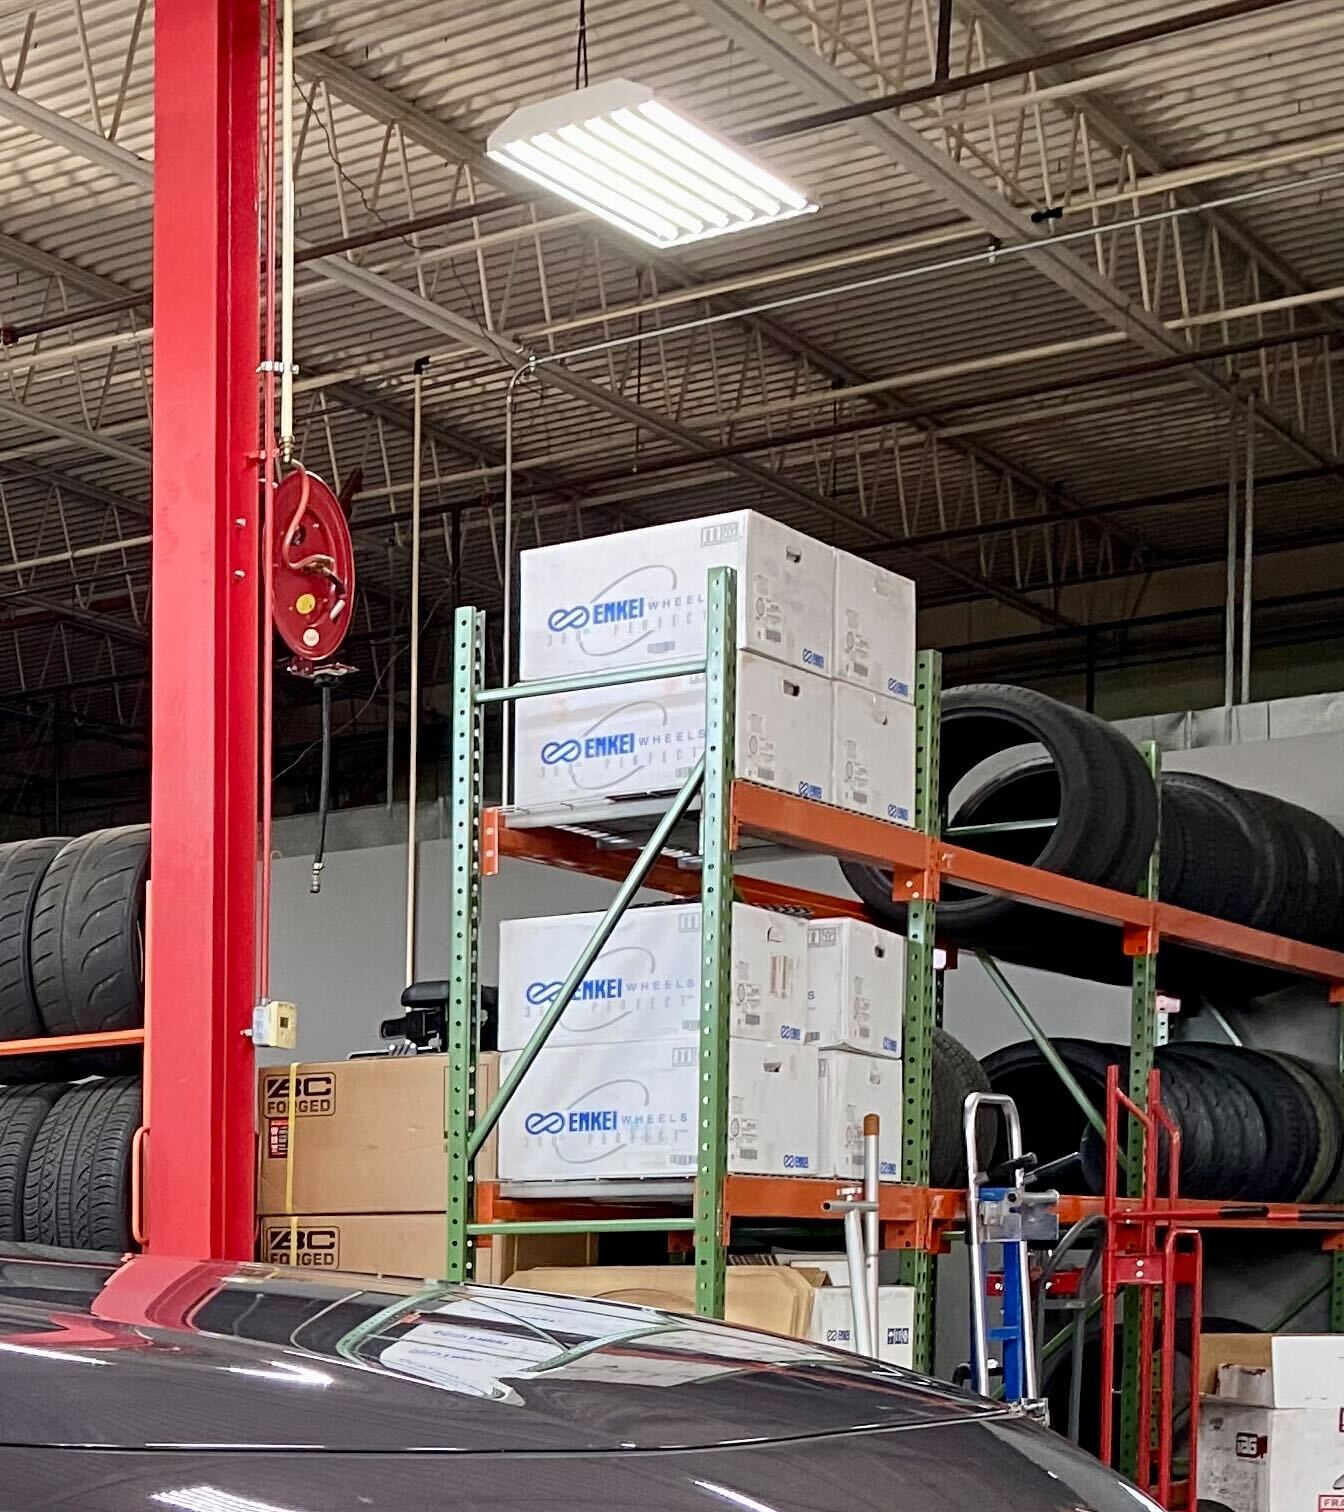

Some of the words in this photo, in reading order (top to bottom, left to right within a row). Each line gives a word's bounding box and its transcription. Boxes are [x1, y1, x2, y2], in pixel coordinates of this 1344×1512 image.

[593, 597, 645, 625] ENKEI
[648, 593, 705, 611] WHEEL
[584, 732, 635, 759] ENKEI
[626, 978, 695, 992] WHEELS
[569, 1111, 617, 1132] ENKEI
[622, 1113, 688, 1124] WHEELS
